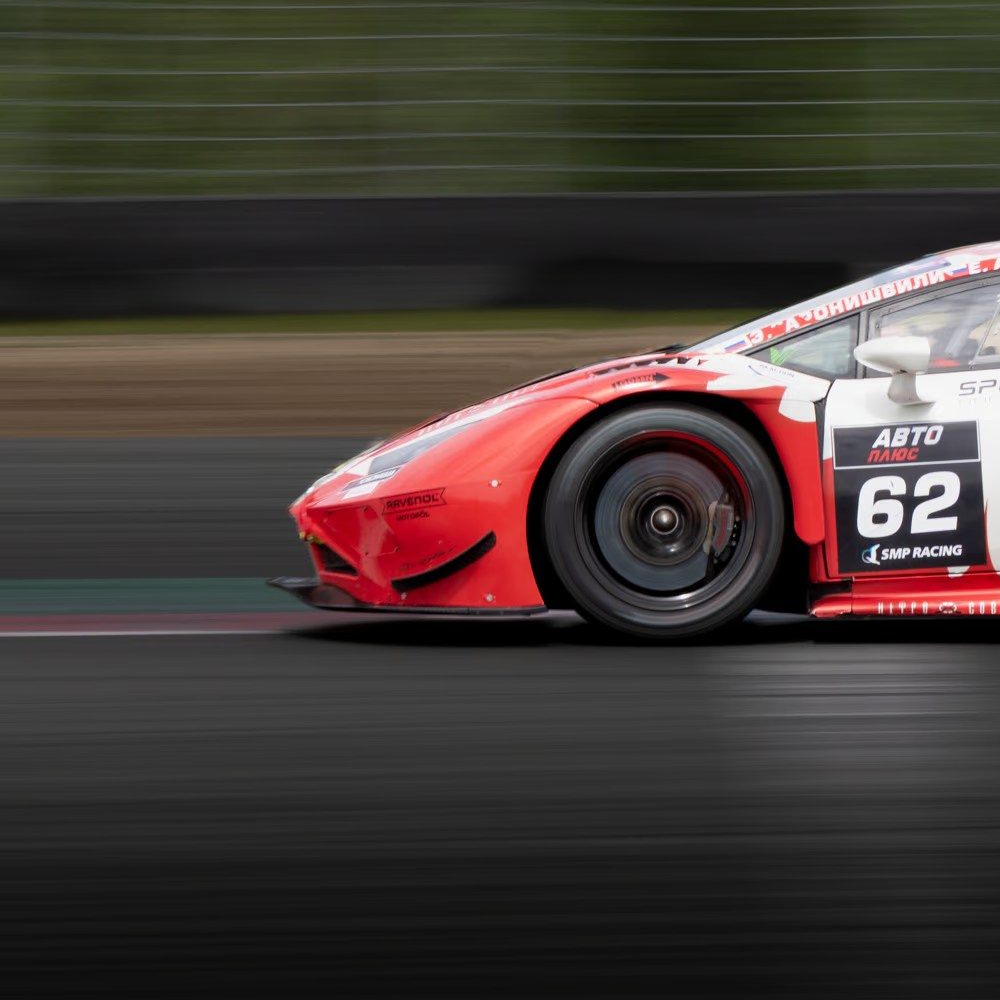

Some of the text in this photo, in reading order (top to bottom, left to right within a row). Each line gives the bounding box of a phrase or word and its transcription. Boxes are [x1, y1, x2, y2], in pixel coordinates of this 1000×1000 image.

[871, 424, 945, 449] АВТО
[867, 447, 920, 463] ПЛЮС
[386, 494, 439, 510] RAVENOL
[856, 470, 961, 539] 62
[881, 544, 963, 561] SMP RACING
